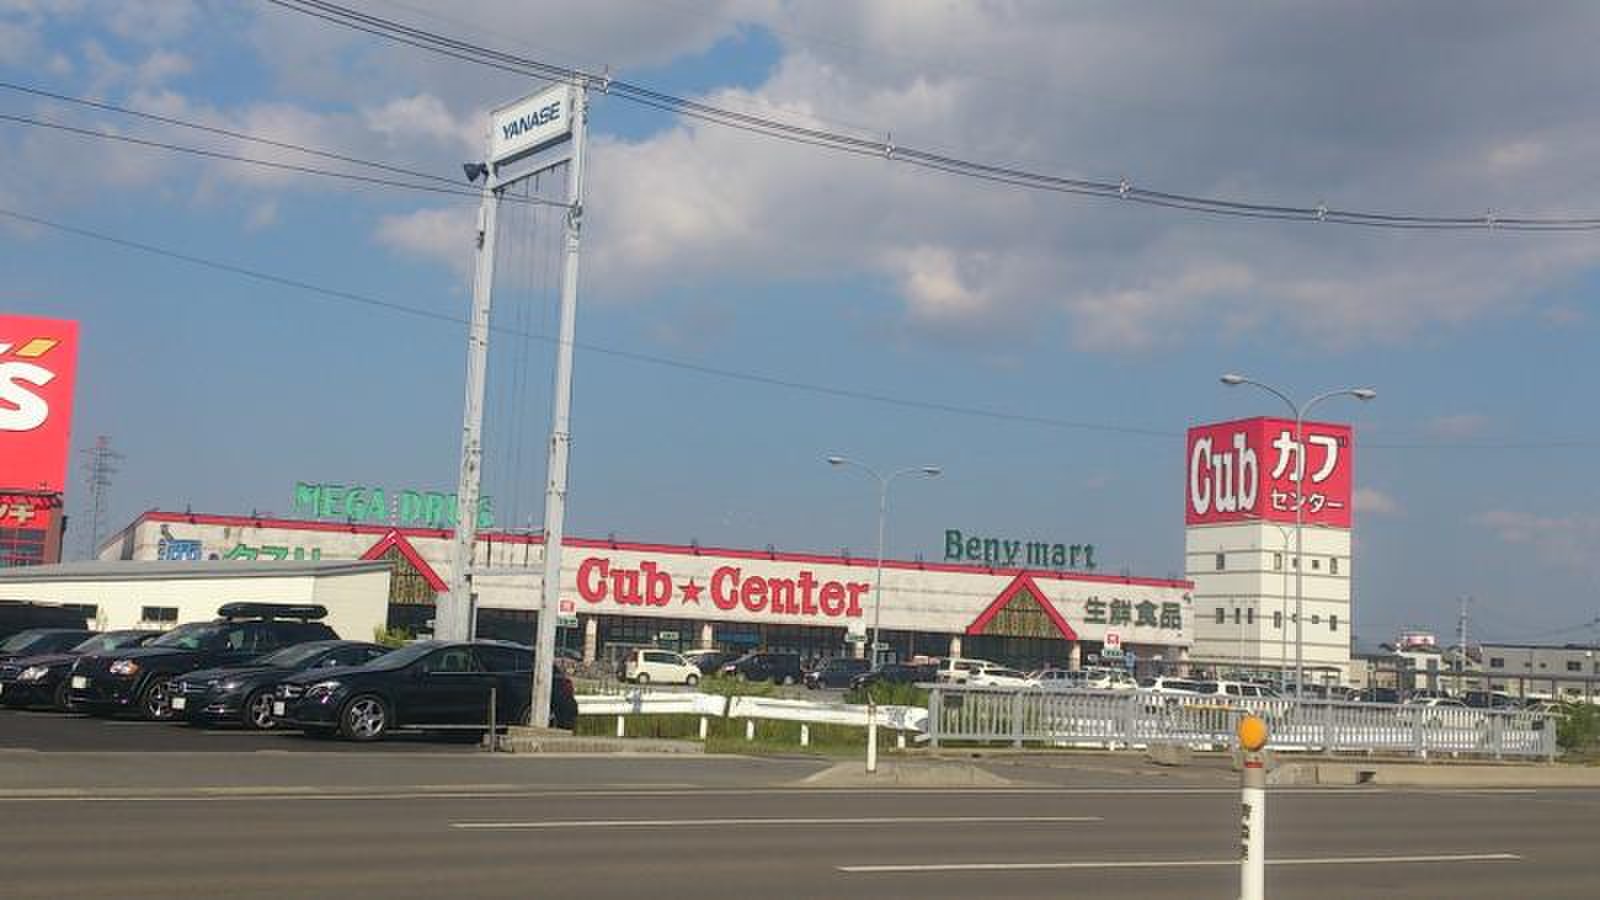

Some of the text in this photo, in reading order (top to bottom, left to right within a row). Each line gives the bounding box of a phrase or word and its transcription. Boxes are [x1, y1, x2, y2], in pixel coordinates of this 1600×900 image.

[502, 101, 561, 140] YANASE
[1190, 432, 1259, 515] Cub
[1270, 431, 1346, 483] カブ
[293, 482, 385, 521] MEGA
[1271, 489, 1345, 514] センター
[944, 529, 1098, 568] Beny mart
[576, 557, 870, 618] Cub Center
[1083, 596, 1183, 631] 生鮮食品
